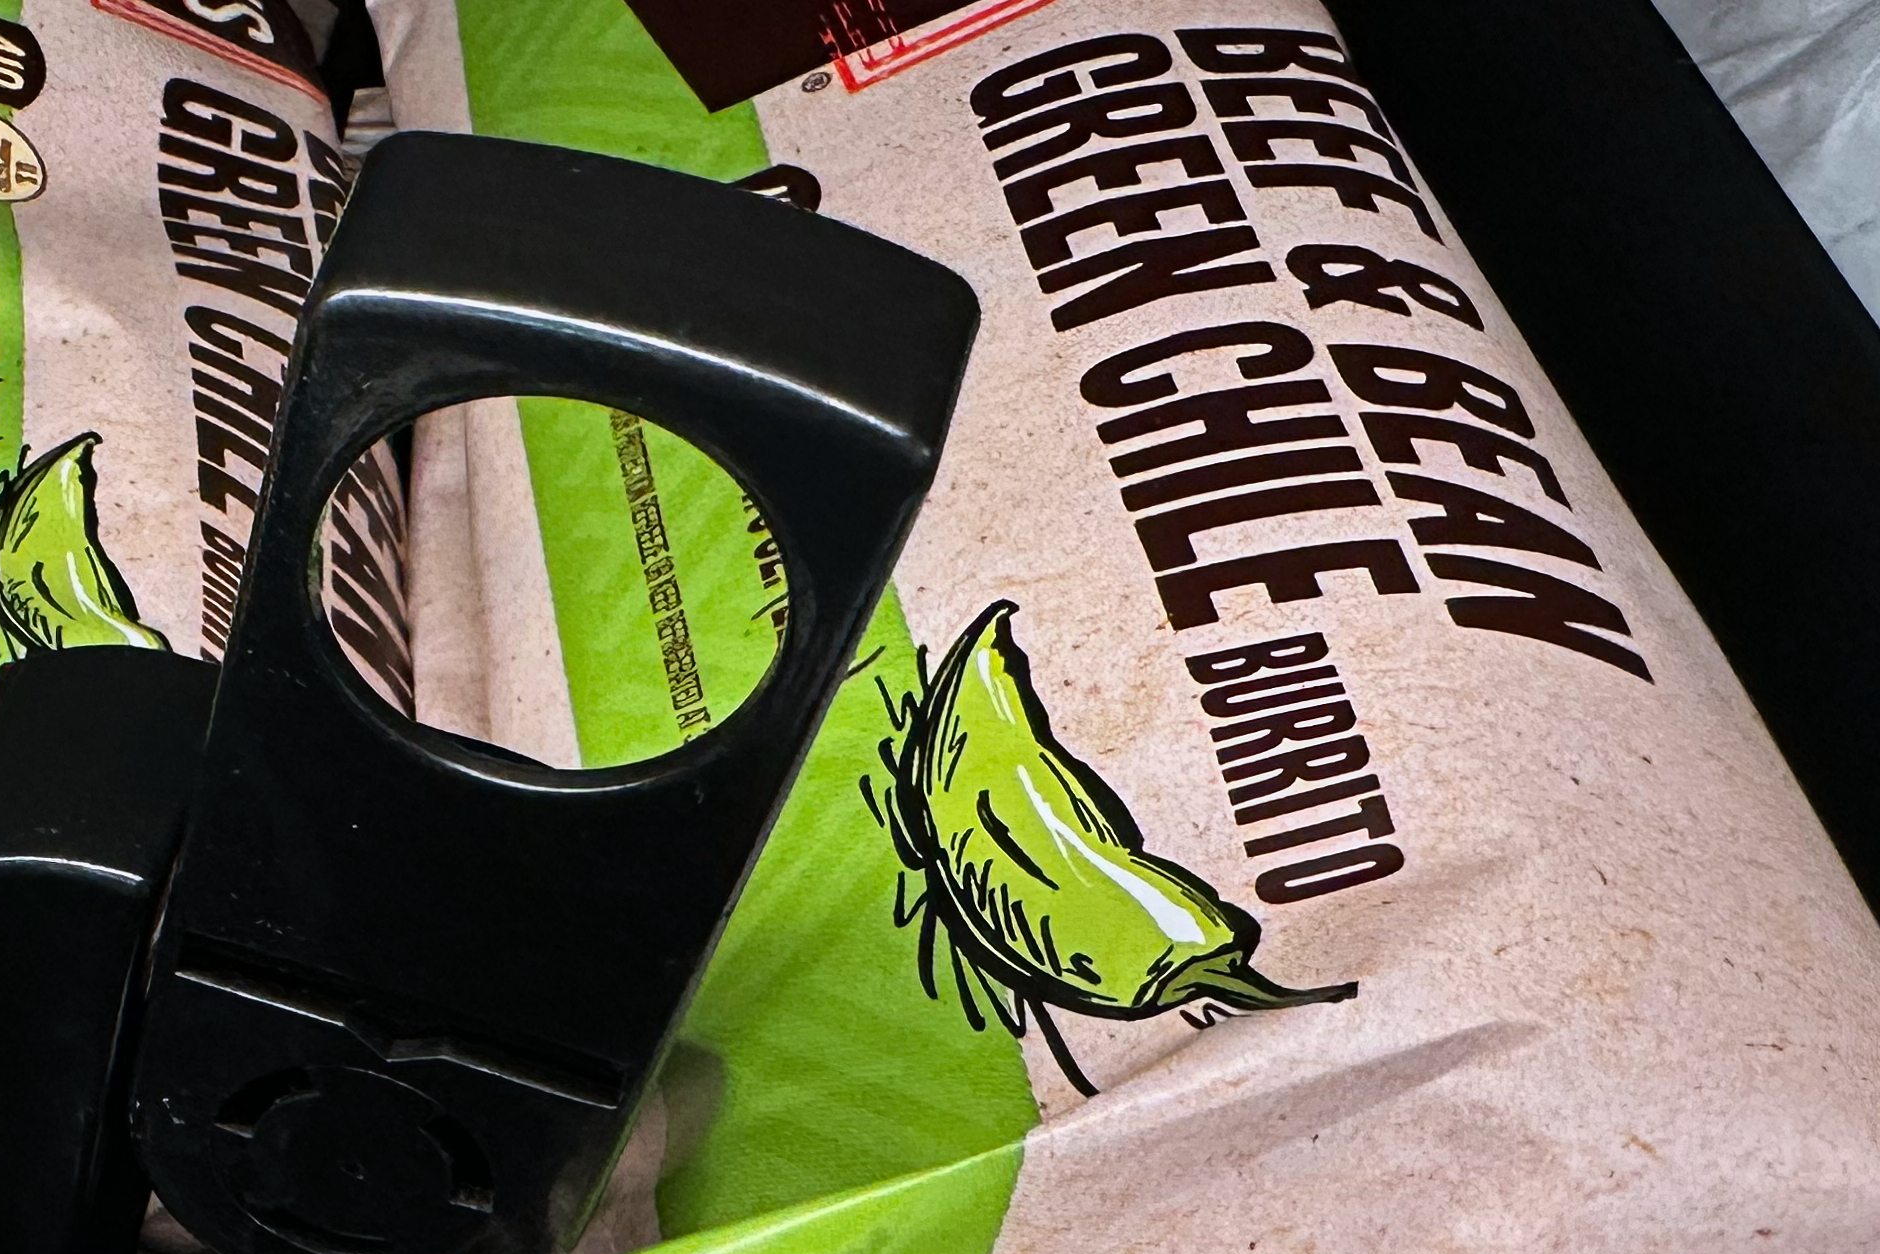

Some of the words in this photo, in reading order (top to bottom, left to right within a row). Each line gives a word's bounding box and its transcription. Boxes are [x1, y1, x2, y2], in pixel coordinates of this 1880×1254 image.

[160, 78, 320, 320] GREEN
[970, 32, 1277, 332] GREEN
[1173, 28, 1445, 245] BEEF
[1284, 243, 1485, 331] &
[1079, 320, 1421, 632] CHILE
[1325, 343, 1655, 684] BEAN
[1185, 631, 1406, 906] BURRITO
